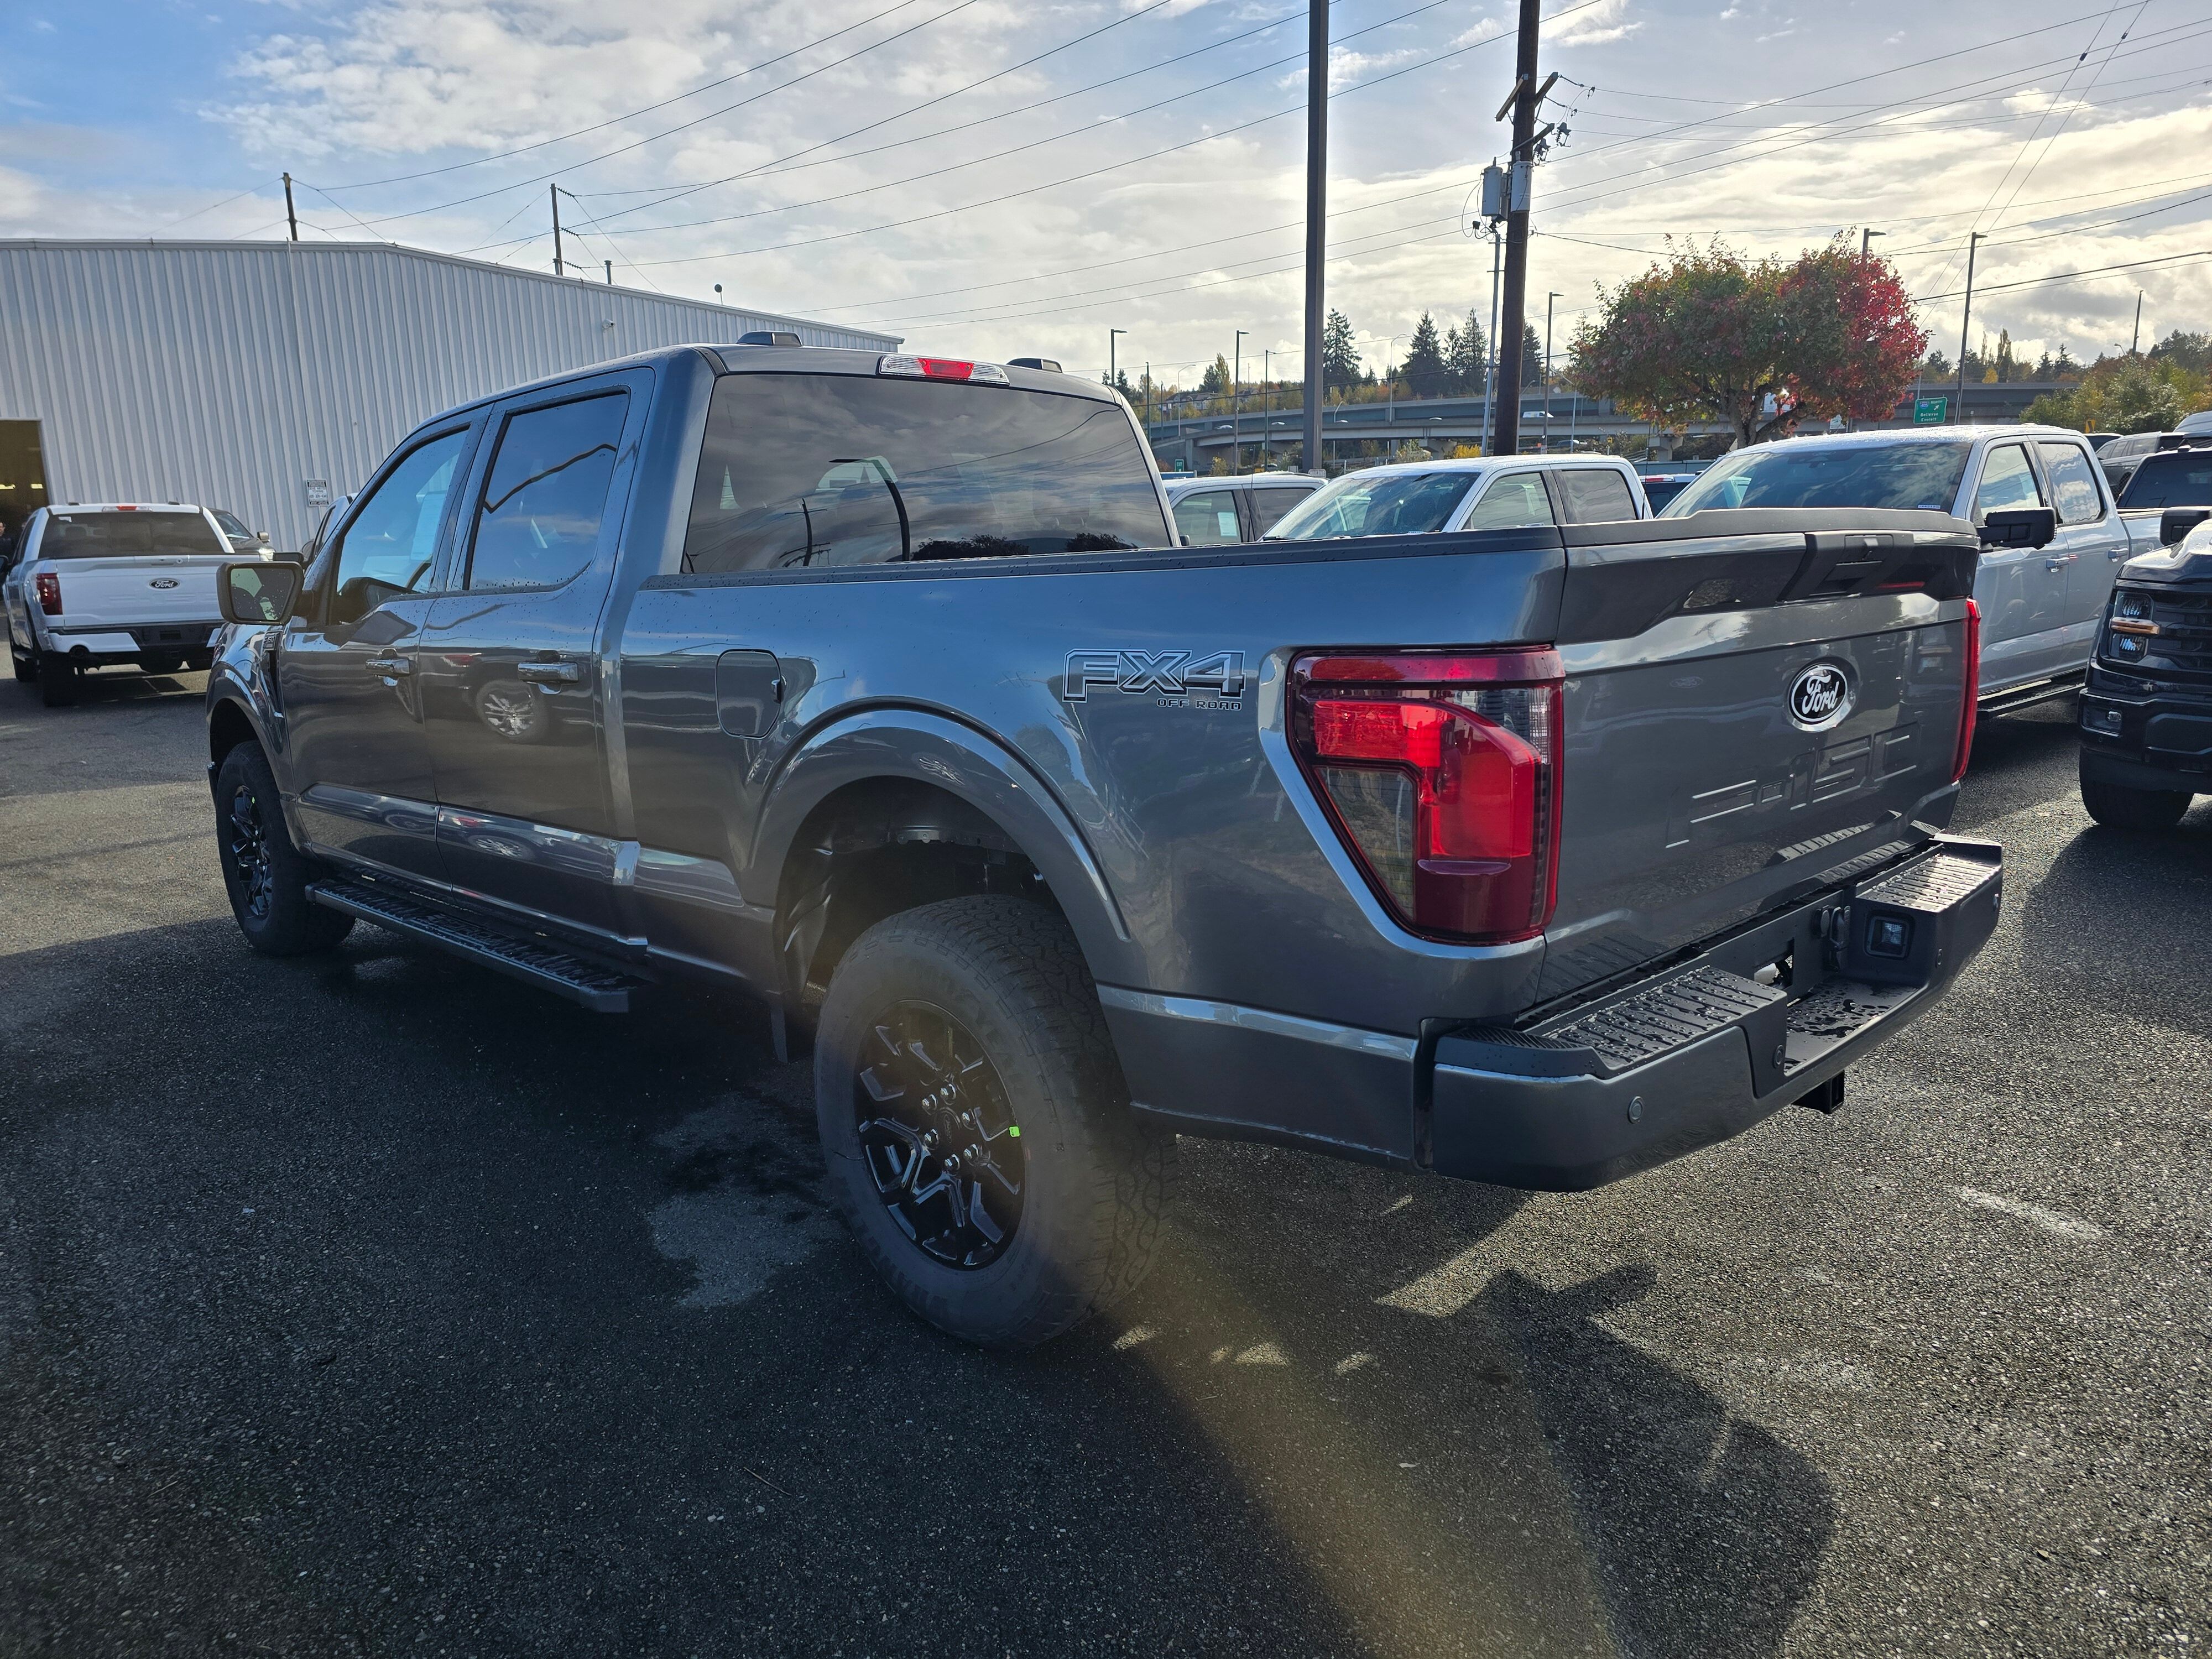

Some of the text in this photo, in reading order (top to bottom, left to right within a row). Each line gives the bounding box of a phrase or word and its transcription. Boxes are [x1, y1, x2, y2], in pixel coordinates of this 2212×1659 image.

[1062, 648, 1246, 703] FX4
[1802, 675, 1840, 714] Ford
[1157, 698, 1243, 711] OFF ROAD
[1665, 721, 1921, 848] F-150
